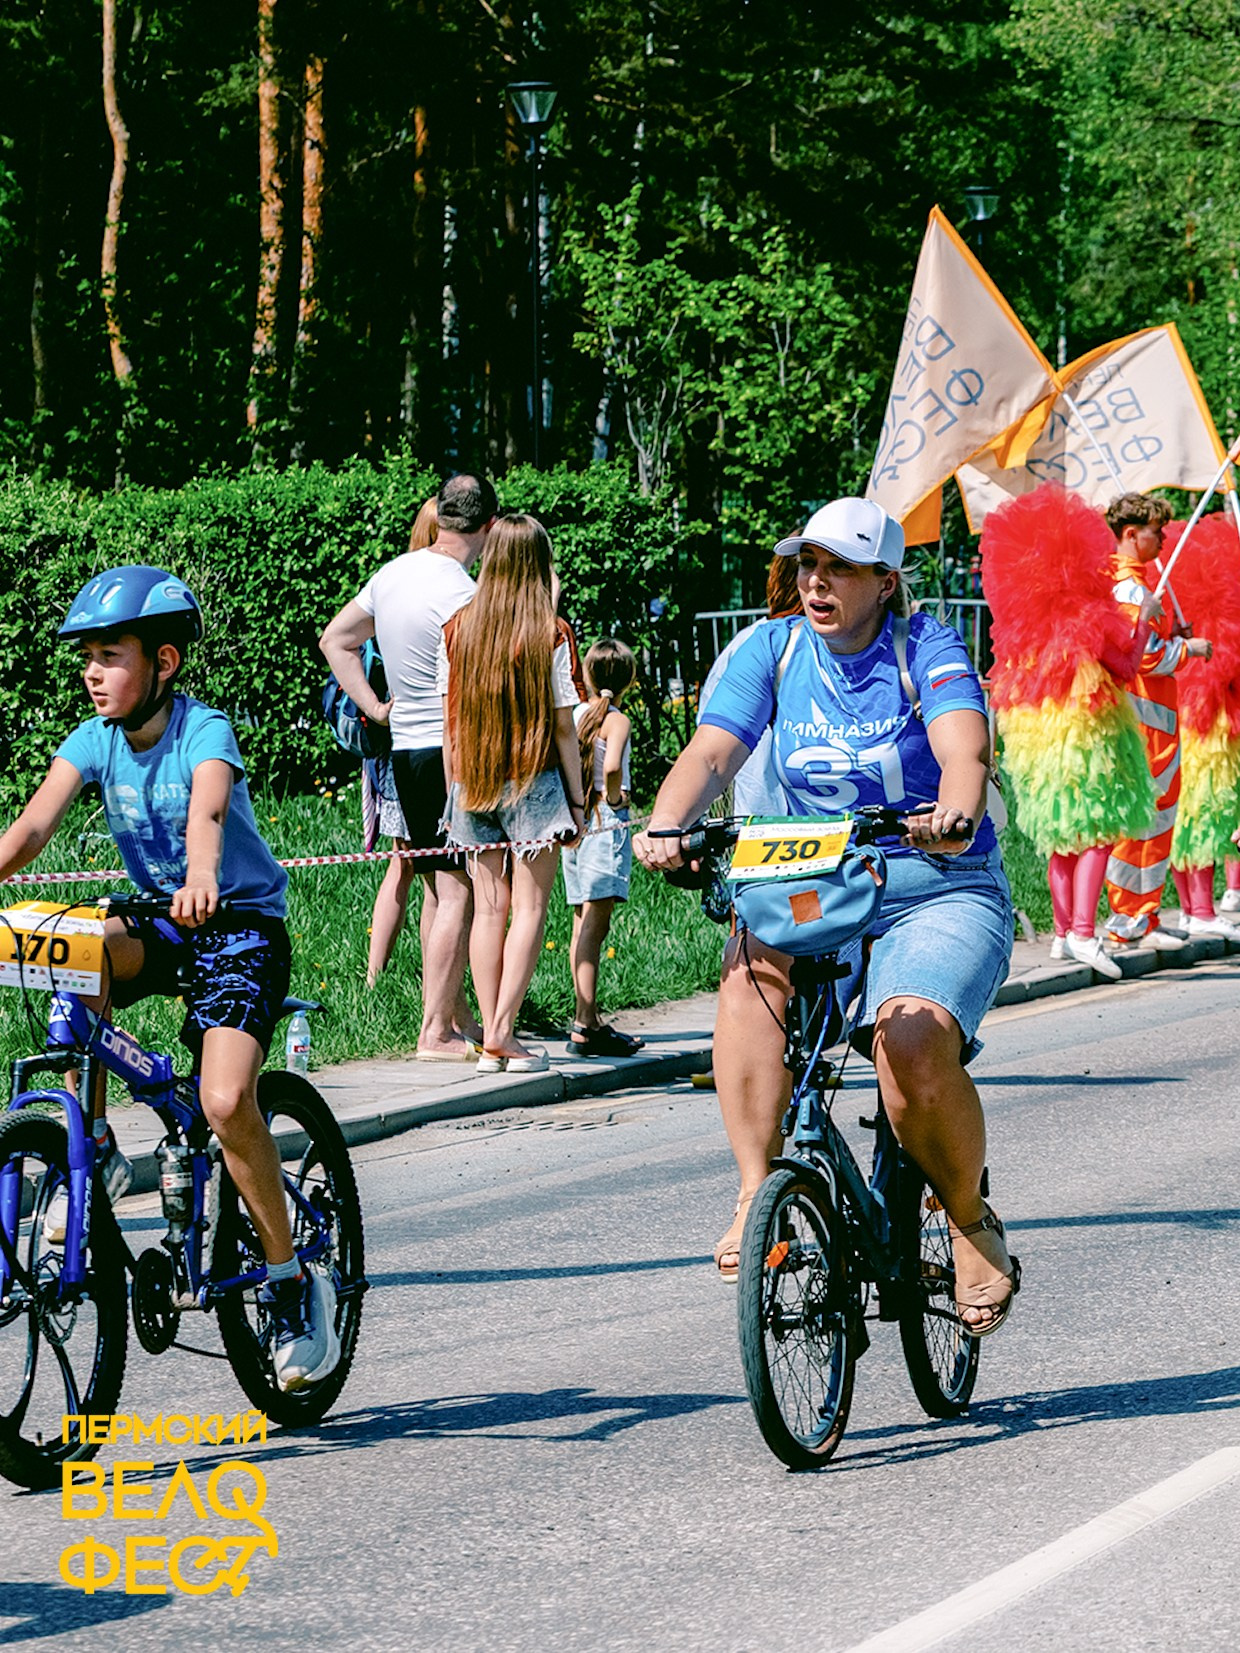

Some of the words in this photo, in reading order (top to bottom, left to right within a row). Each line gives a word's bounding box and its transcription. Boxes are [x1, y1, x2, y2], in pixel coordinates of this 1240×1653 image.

[785, 741, 906, 811] 31
[760, 839, 821, 864] 730
[11, 932, 70, 966] 170
[101, 1027, 154, 1077] DINOS
